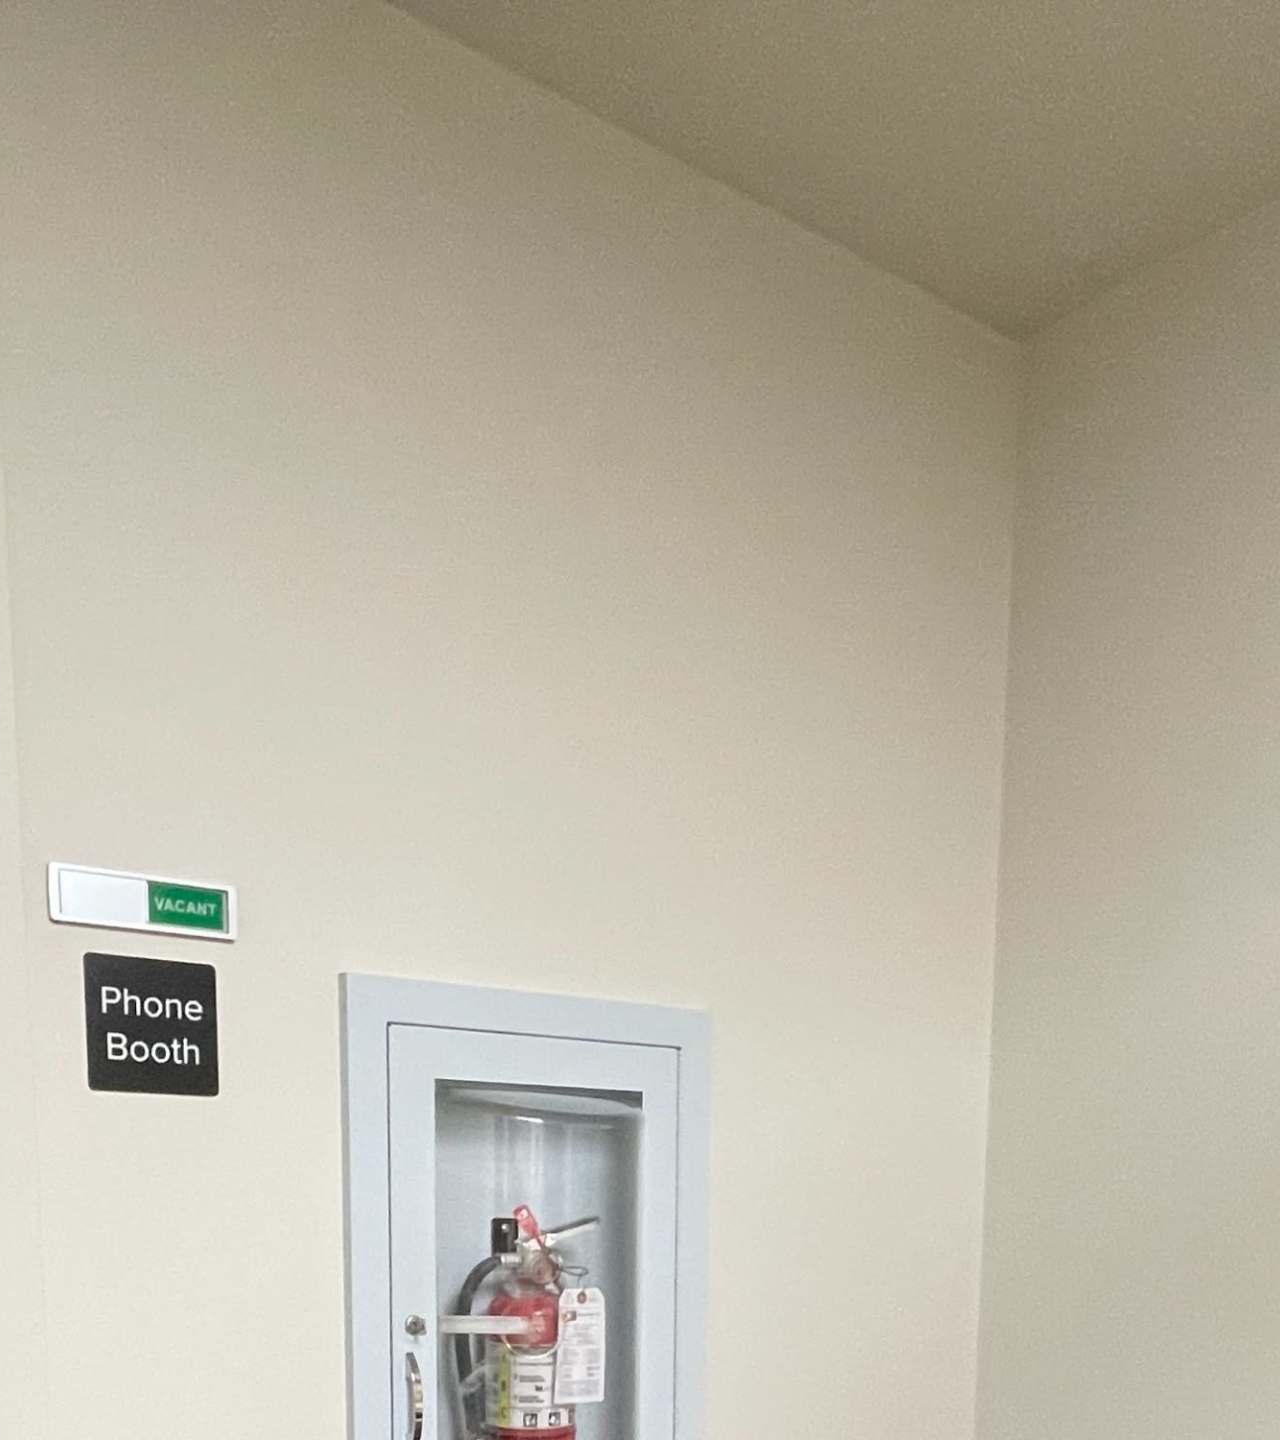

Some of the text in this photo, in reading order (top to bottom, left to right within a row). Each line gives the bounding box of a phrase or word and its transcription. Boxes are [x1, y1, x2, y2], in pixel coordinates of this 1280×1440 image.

[154, 896, 216, 915] VACANT
[100, 986, 204, 1021] Phone
[106, 1031, 200, 1065] Booth
